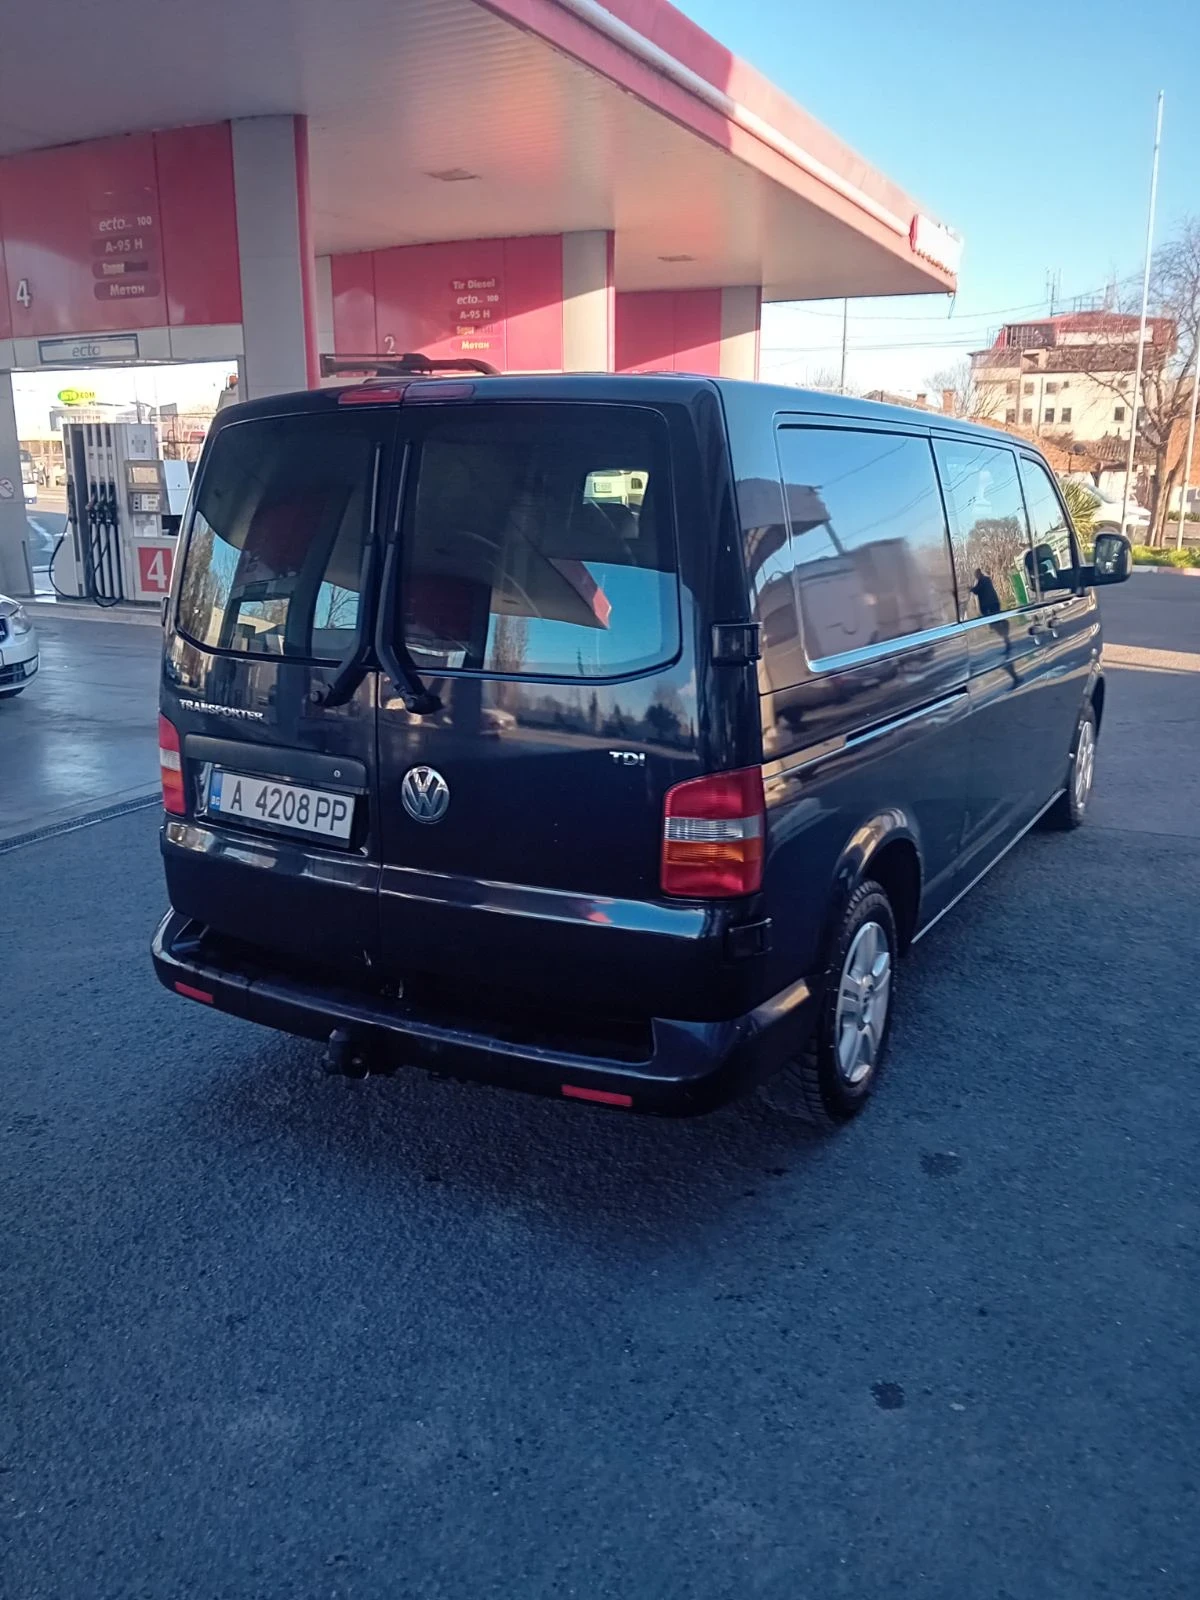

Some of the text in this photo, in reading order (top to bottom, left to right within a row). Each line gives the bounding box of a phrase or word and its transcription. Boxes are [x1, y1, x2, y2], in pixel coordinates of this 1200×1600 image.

[98, 215, 152, 231] ecto 100
[109, 283, 145, 297] Метан
[467, 278, 496, 289] Diesel
[16, 279, 31, 308] 4
[456, 294, 499, 305] ecto 100
[72, 343, 101, 357] ecto
[384, 335, 396, 355] 2
[461, 340, 490, 350] Метан
[147, 550, 168, 590] 4
[179, 698, 264, 720] TRANSPORTER
[609, 751, 646, 767] TDI
[230, 780, 243, 811] A
